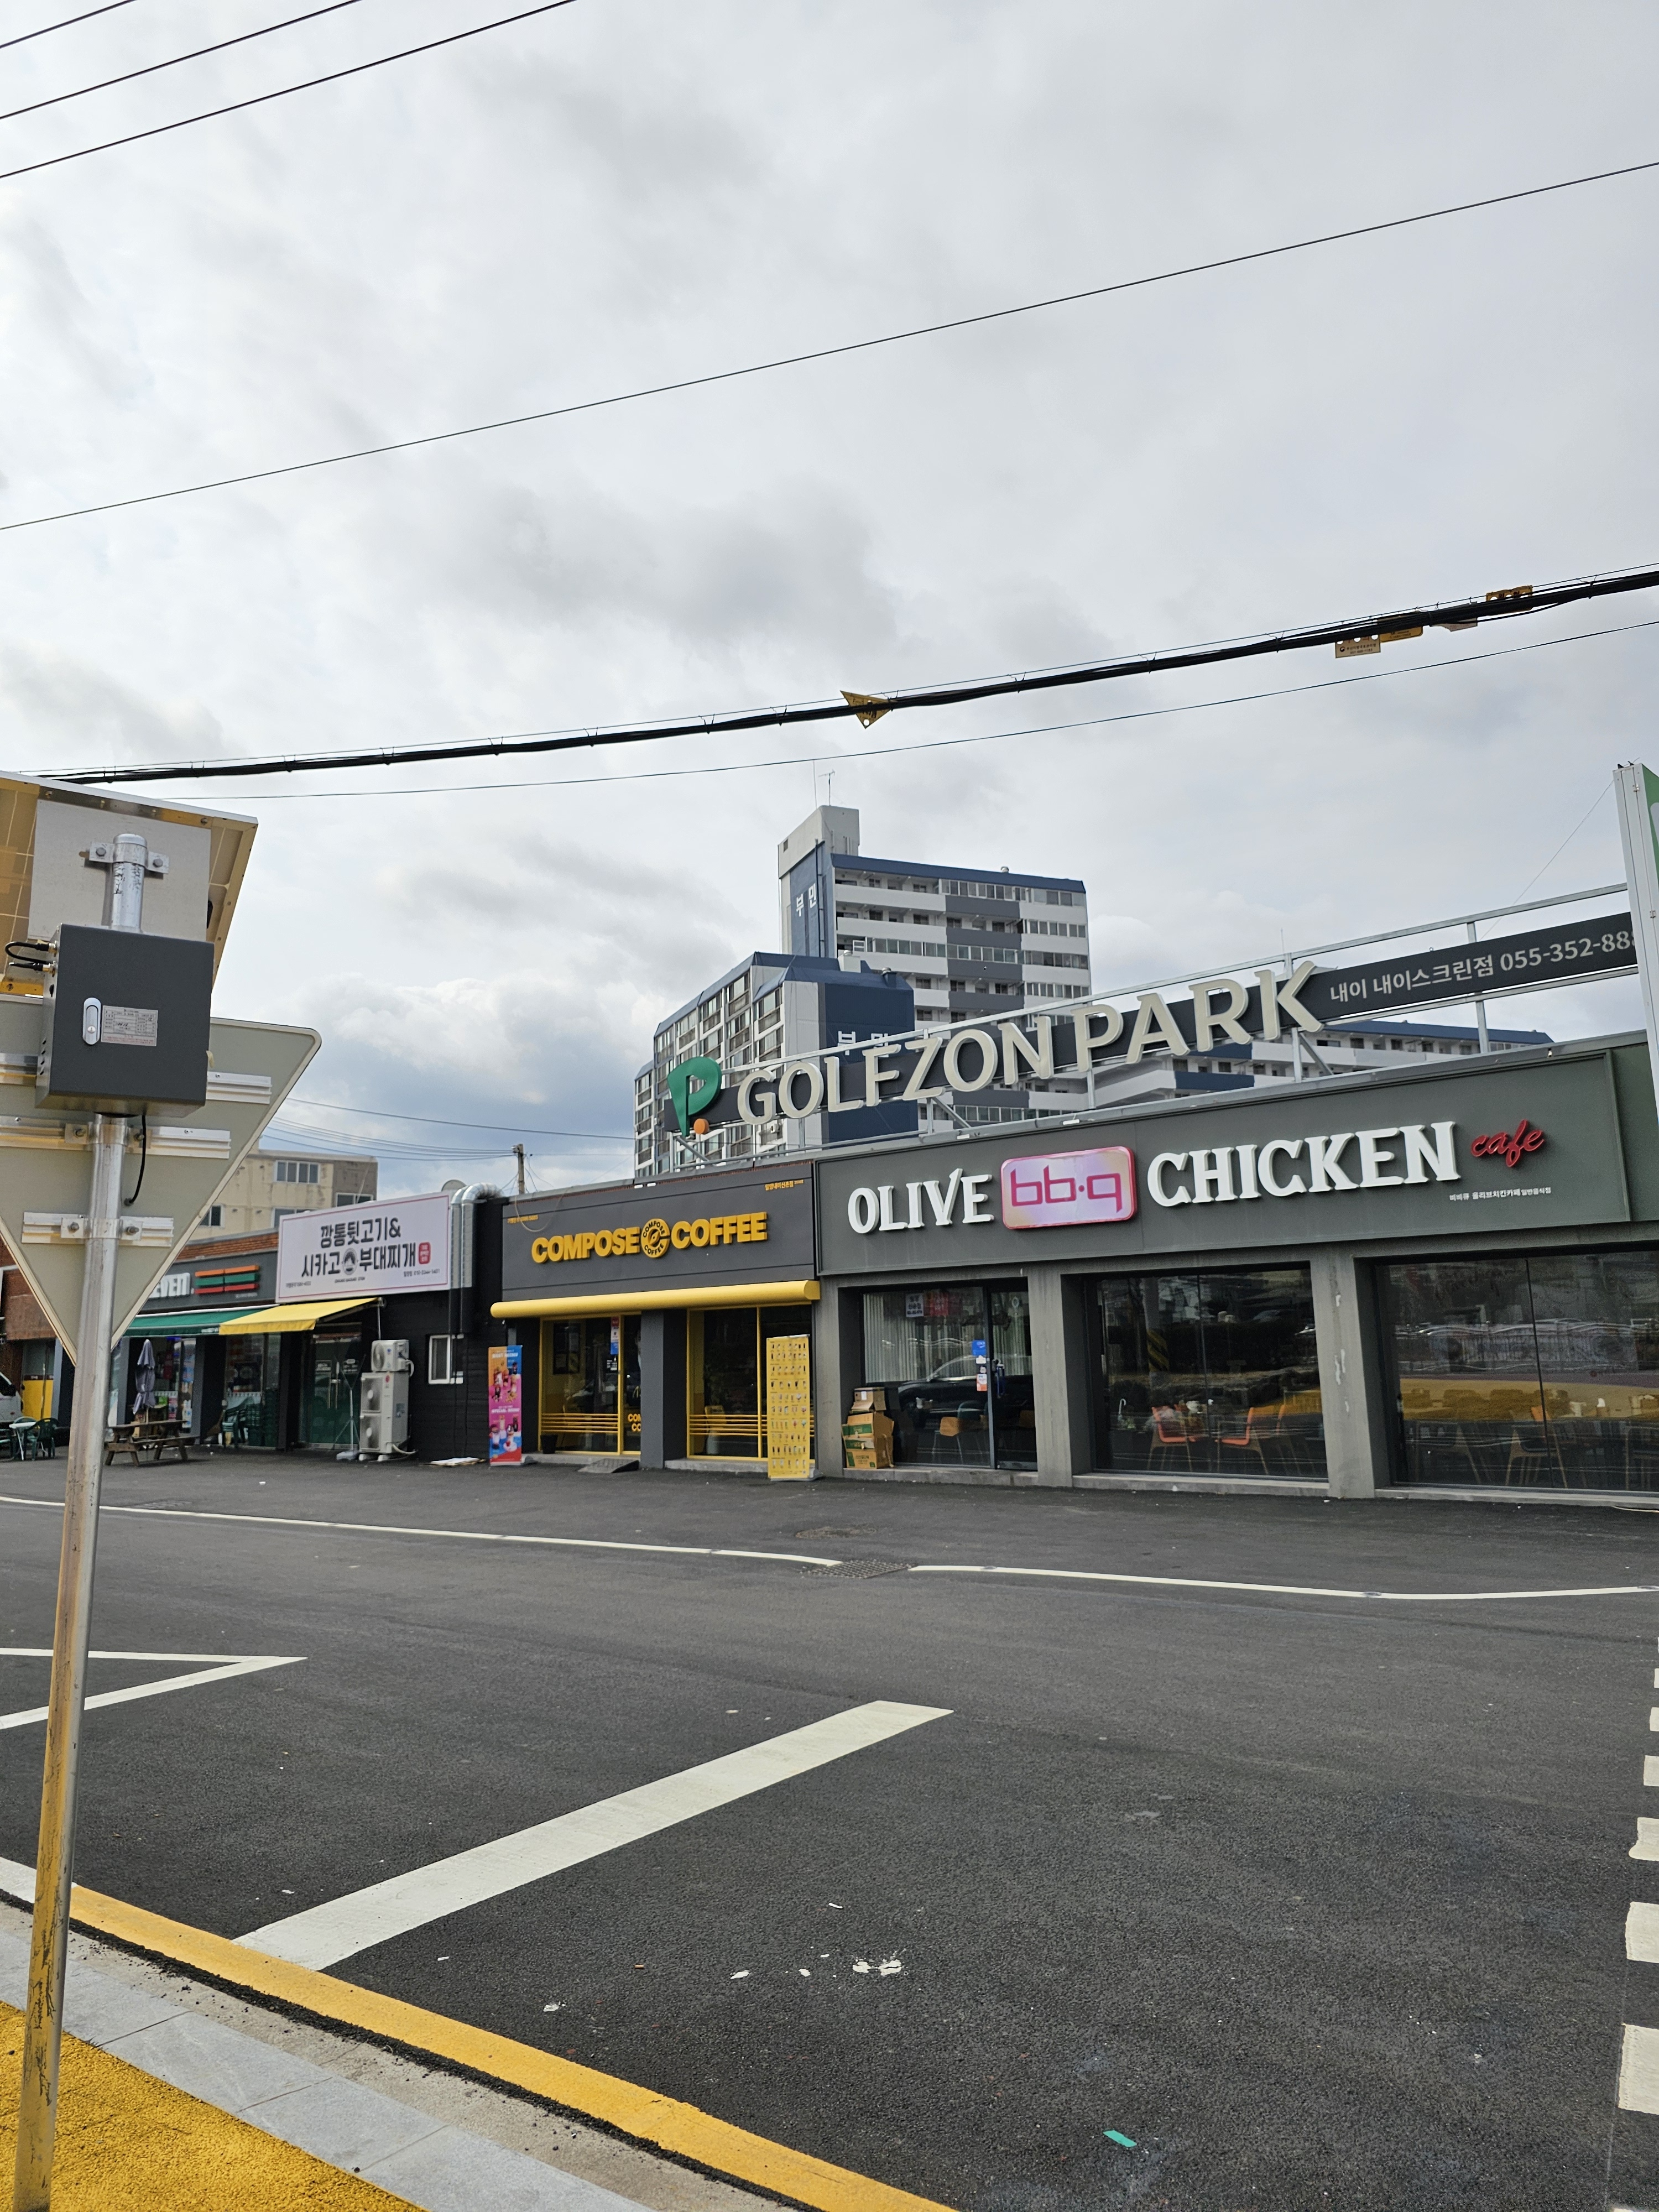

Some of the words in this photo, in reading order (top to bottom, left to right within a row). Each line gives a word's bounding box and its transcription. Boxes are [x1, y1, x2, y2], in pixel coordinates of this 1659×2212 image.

[796, 883, 816, 917] 부민
[1331, 979, 1367, 1003] 내이
[1374, 954, 1494, 995] 내이스크린점
[737, 1016, 1055, 1125] GOLFZON
[1071, 960, 1325, 1073] PARK
[848, 1168, 994, 1234] OLIVE
[1147, 1121, 1460, 1207] CHICKEN
[1470, 1119, 1545, 1167] cafe
[320, 1217, 401, 1248] 깡통뒷고기&
[531, 1227, 640, 1264] COMPOSE
[671, 1212, 768, 1249] COFFEE
[301, 1251, 341, 1277] 시카고
[359, 1242, 416, 1271] 부대찌개
